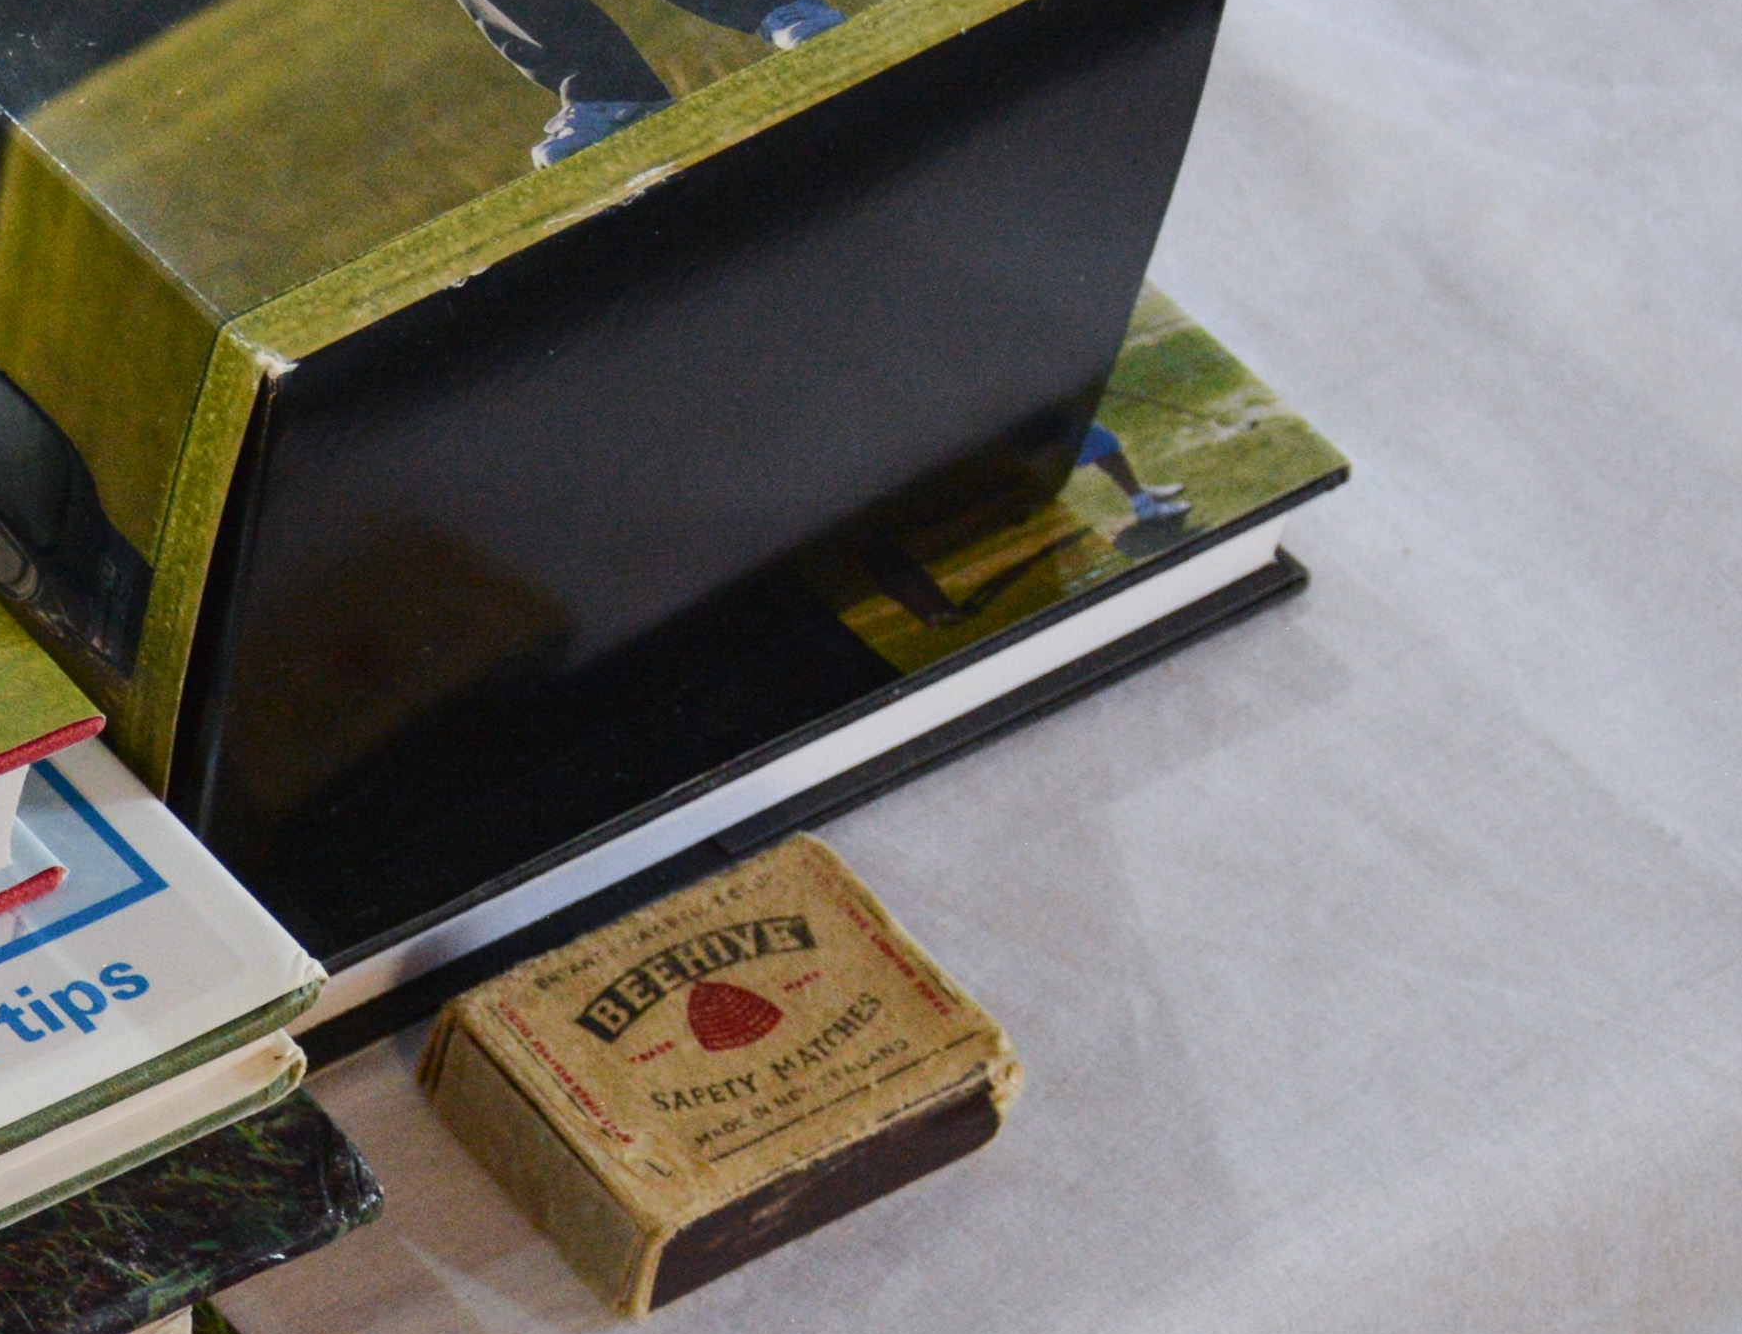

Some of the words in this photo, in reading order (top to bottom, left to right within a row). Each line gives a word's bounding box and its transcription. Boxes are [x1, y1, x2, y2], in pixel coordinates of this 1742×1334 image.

[583, 917, 807, 1037] BEEHIVE
[649, 1071, 758, 1112] SAFETY
[769, 991, 882, 1082] MATCHES
